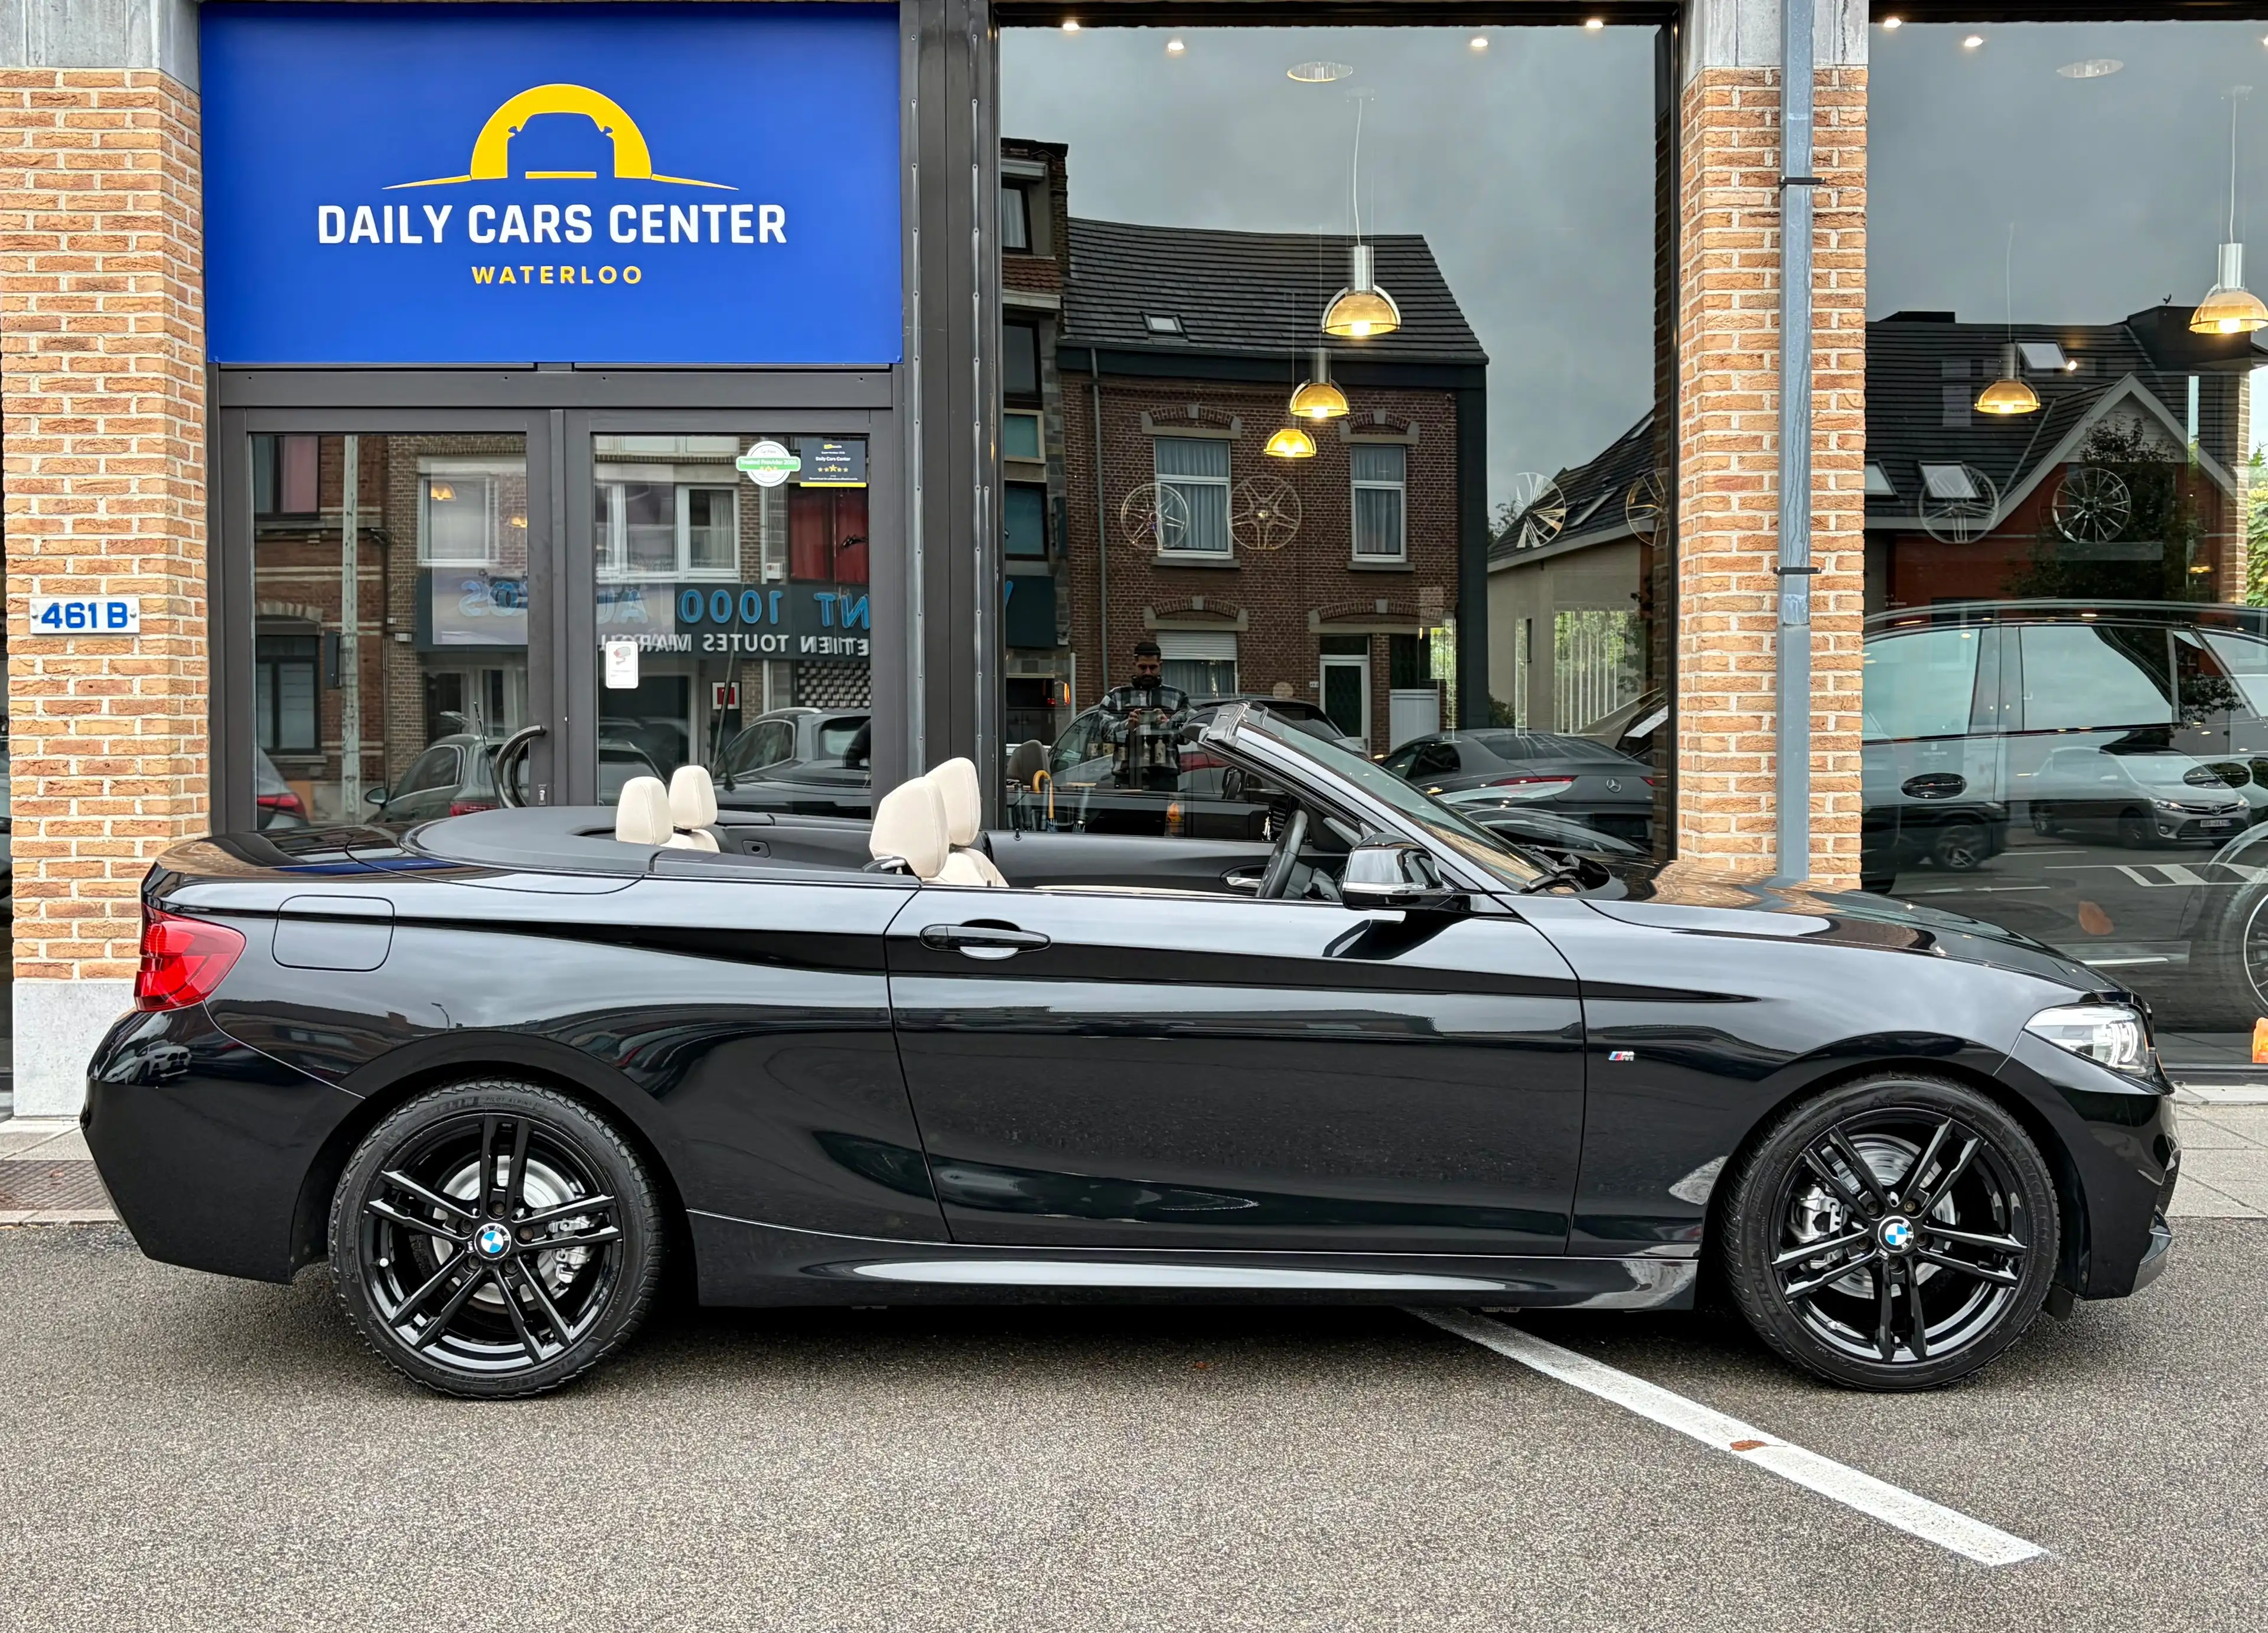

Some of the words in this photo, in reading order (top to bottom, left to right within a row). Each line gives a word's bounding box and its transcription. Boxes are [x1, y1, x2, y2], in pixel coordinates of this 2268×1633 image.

[318, 204, 452, 244] DAILY
[468, 204, 592, 244] CARS
[609, 204, 787, 244] CENTER
[472, 266, 643, 284] WATERLOO
[41, 602, 97, 628] 461
[107, 602, 128, 628] B
